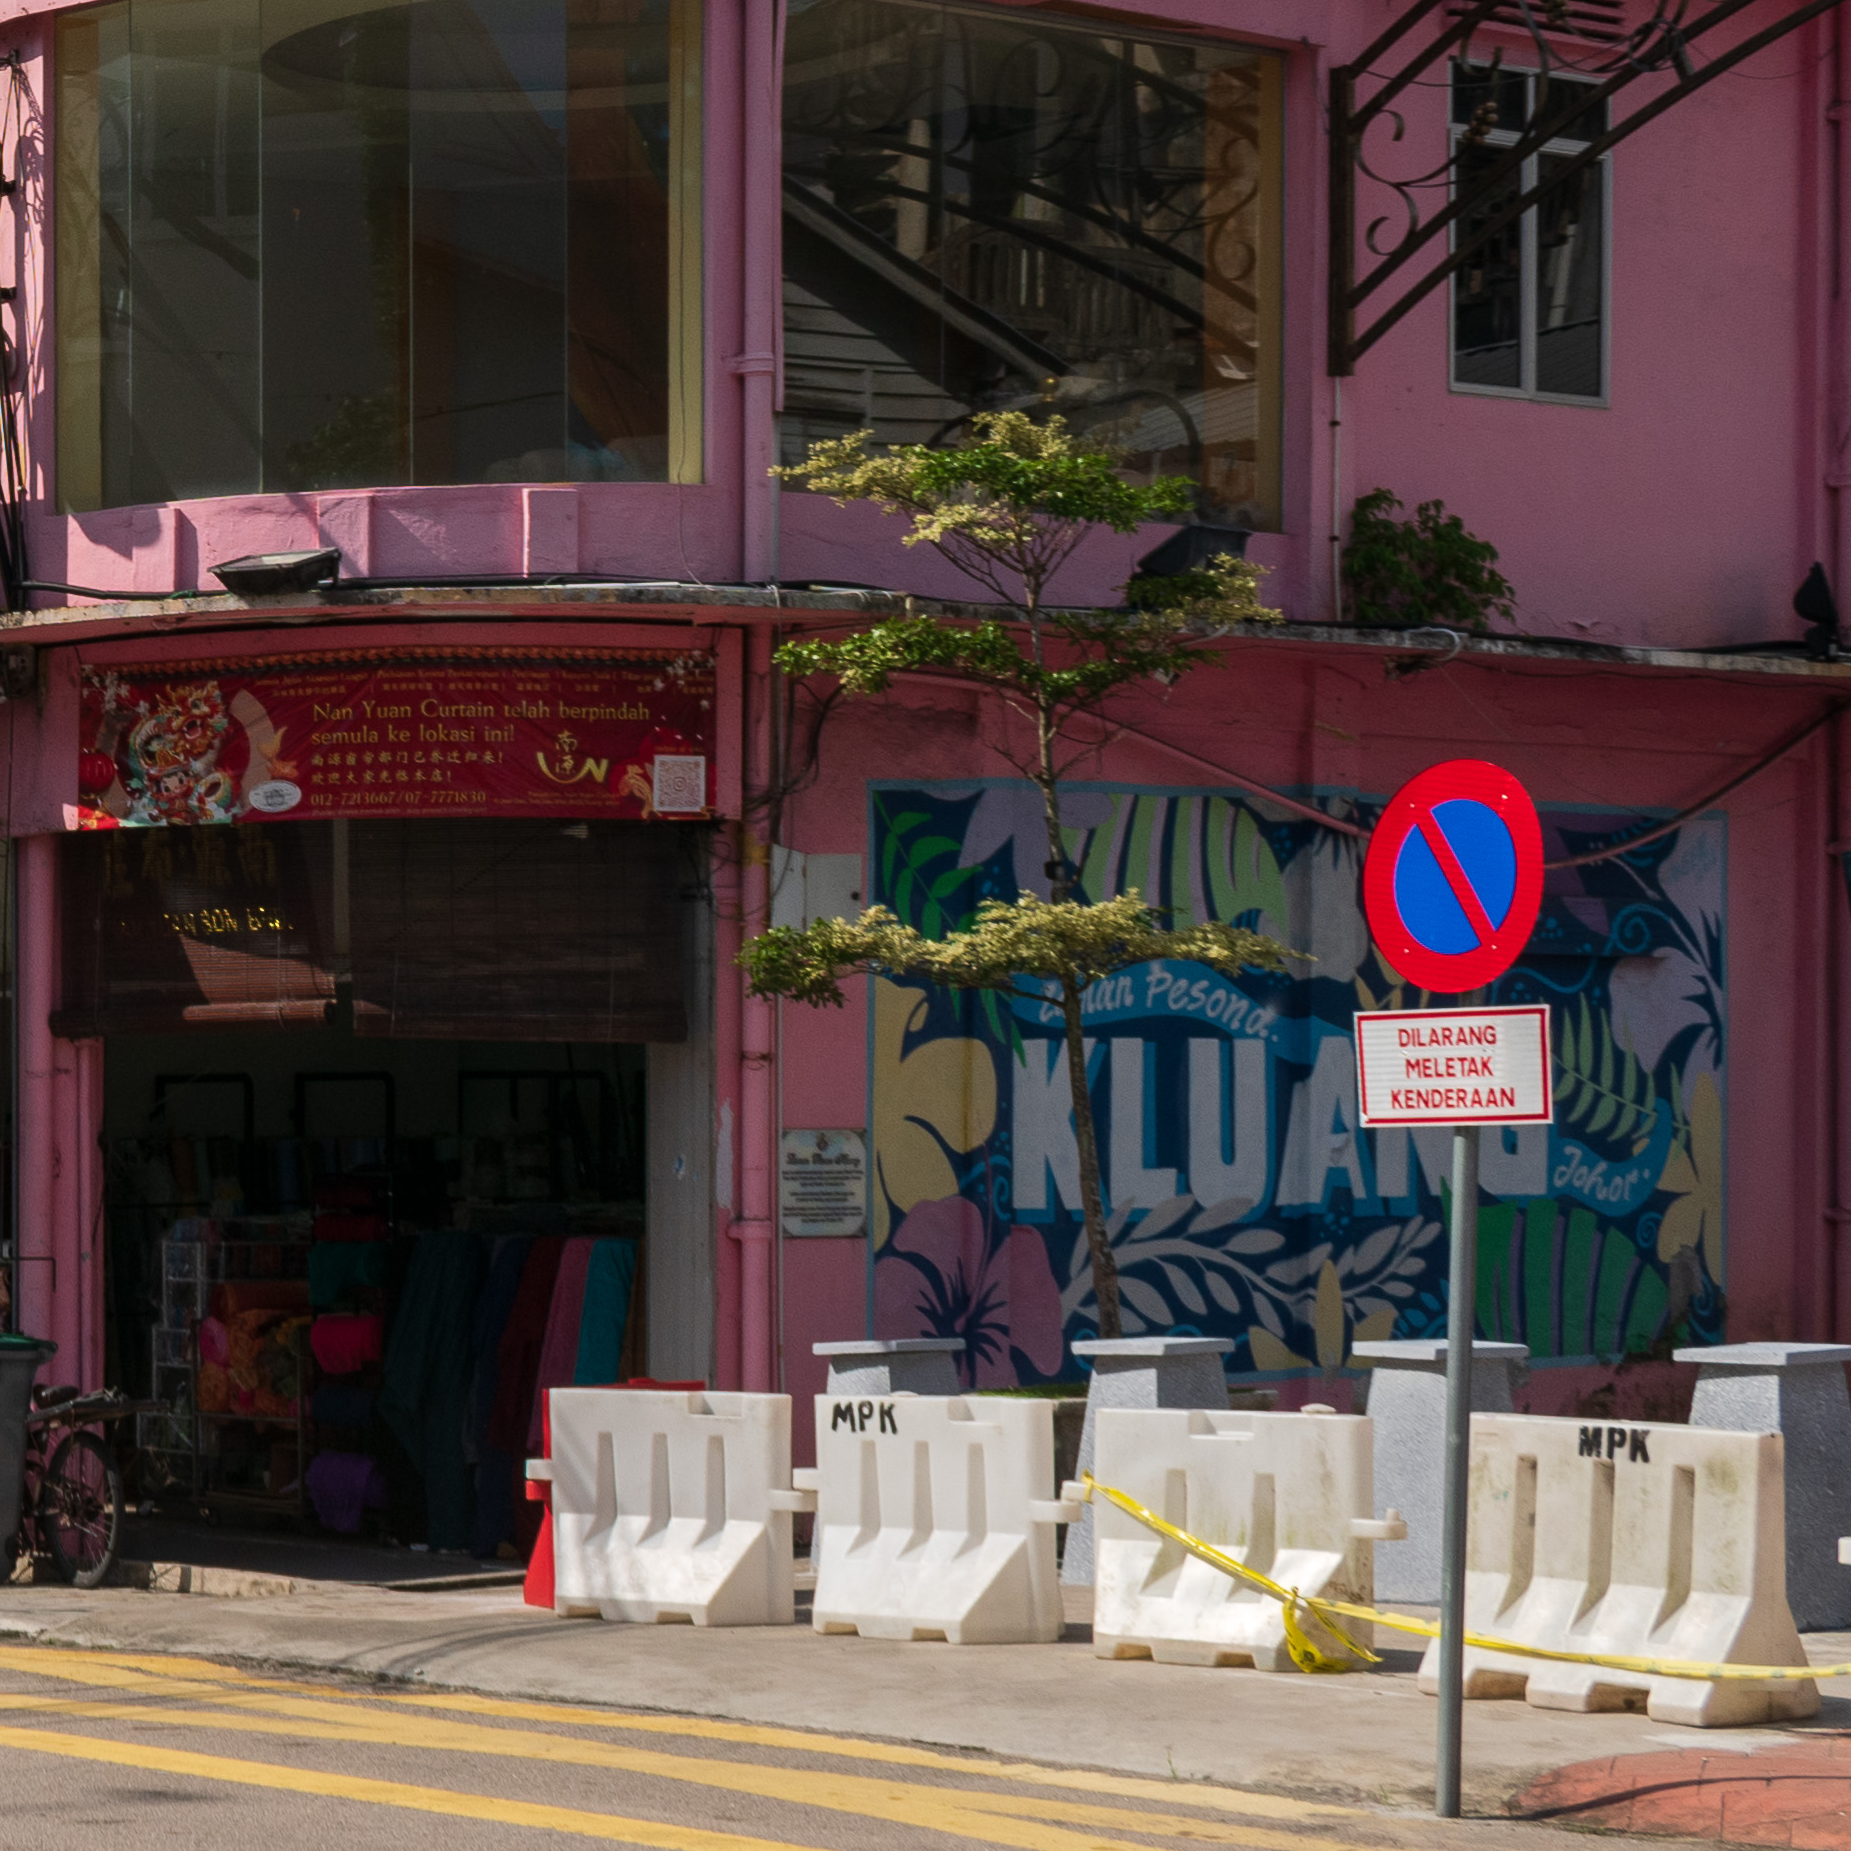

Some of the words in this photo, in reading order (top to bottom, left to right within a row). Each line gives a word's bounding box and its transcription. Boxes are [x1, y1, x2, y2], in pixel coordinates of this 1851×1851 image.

[313, 702, 353, 723] Nan
[362, 700, 412, 719] Yuan
[420, 698, 495, 719] Curtain
[504, 700, 549, 719] telah
[559, 701, 650, 723] berpindah
[311, 725, 379, 745] semula
[388, 724, 411, 743] ke
[419, 723, 475, 743] lokasi
[484, 723, 515, 742] ini!
[1397, 1025, 1498, 1048] DILARANG
[1405, 1056, 1494, 1080] MELETAK
[1391, 1087, 1516, 1110] KENDERAAN
[830, 1401, 899, 1435] MPK
[1577, 1424, 1652, 1464] MPK
